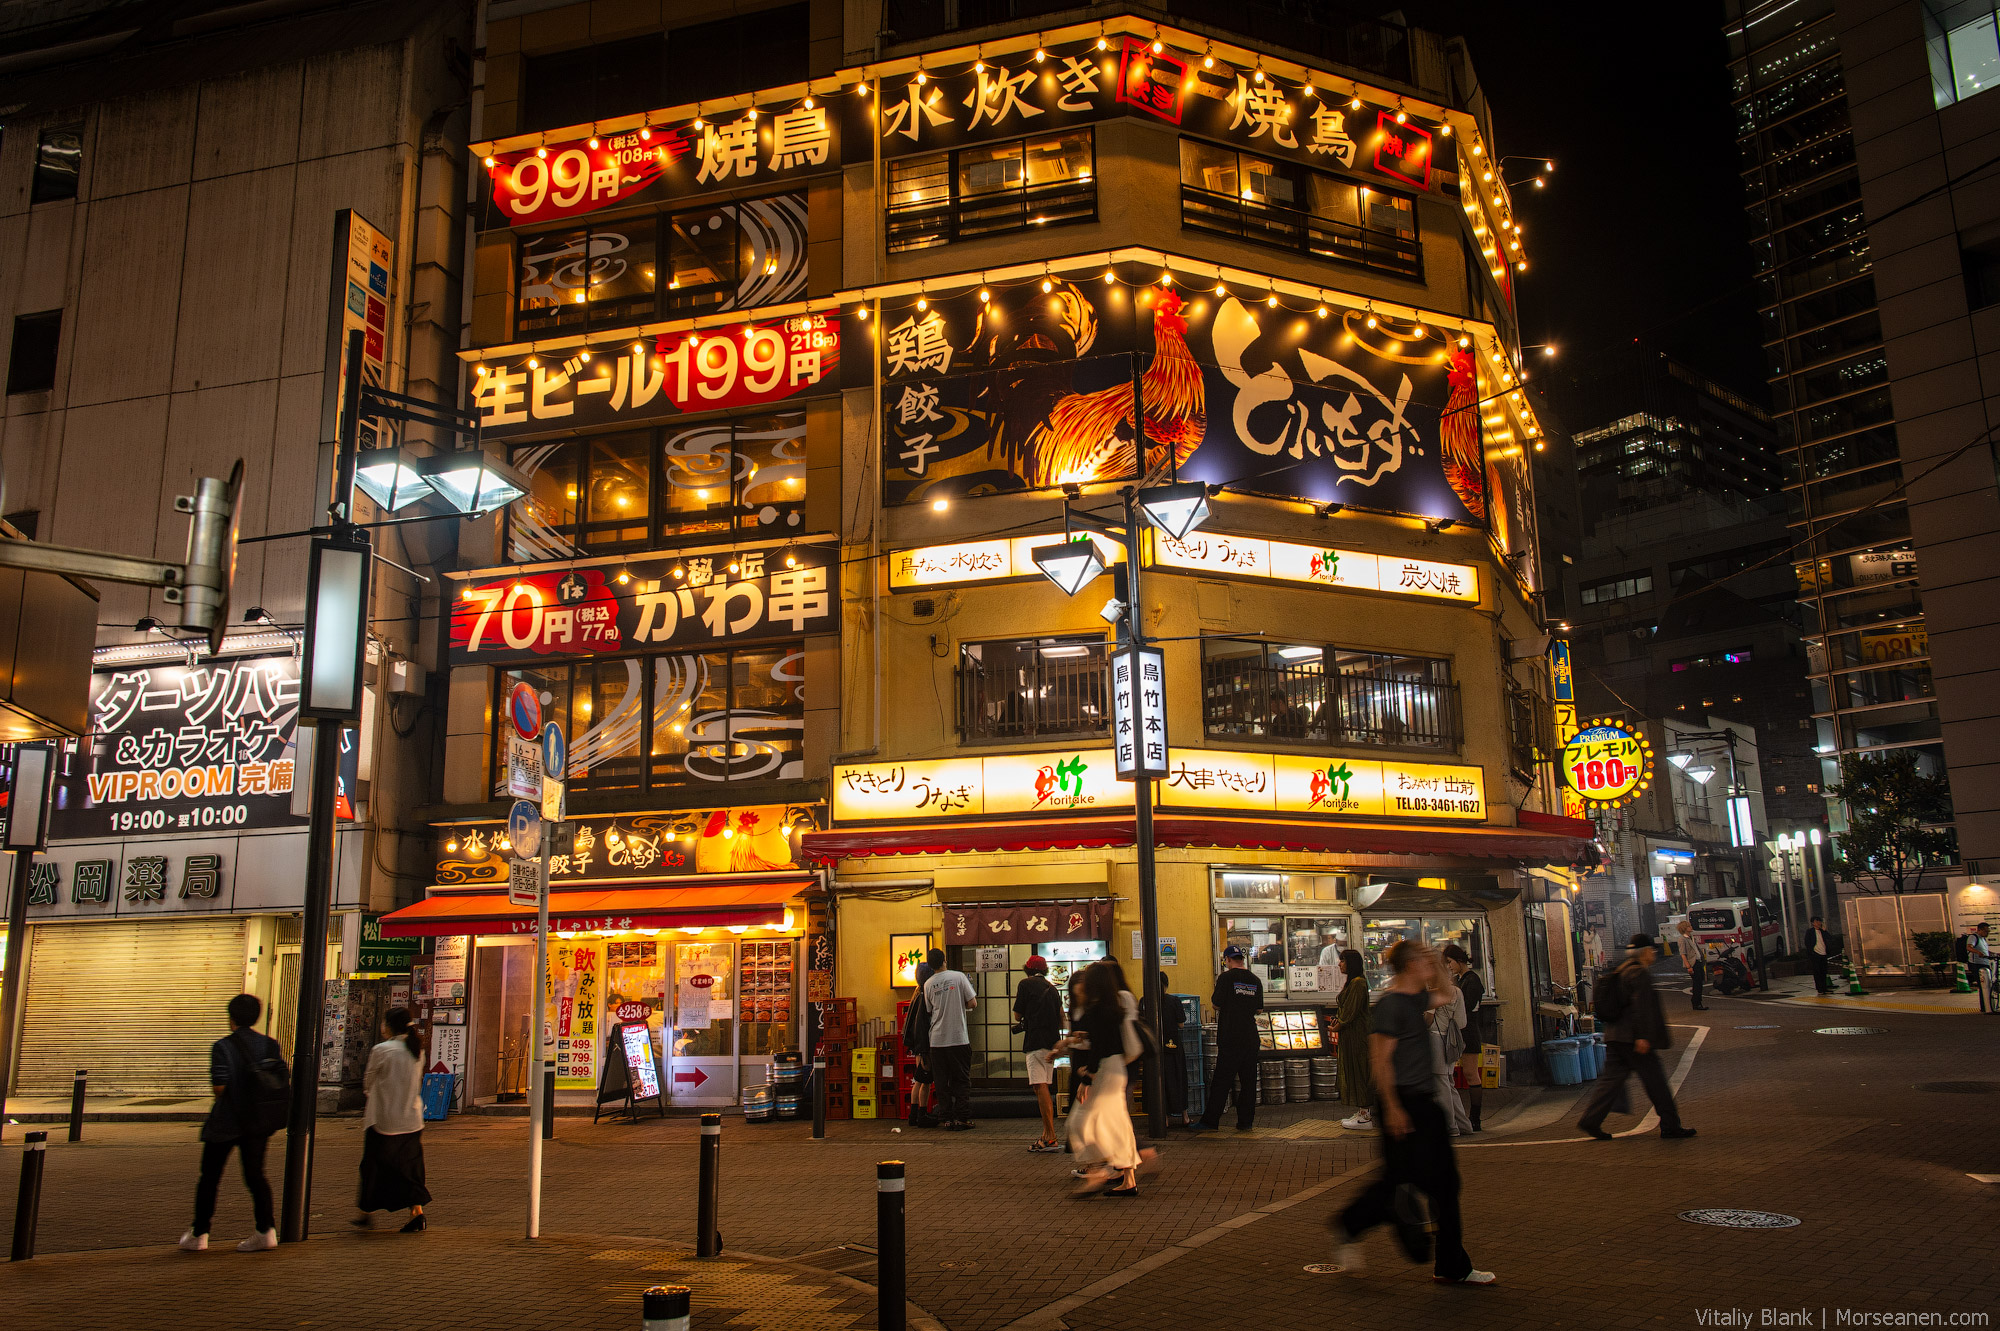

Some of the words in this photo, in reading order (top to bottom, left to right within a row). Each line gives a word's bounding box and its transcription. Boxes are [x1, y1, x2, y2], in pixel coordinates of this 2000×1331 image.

[884, 55, 1100, 141] 水炊き
[1225, 72, 1357, 168] 焼鳥
[696, 107, 831, 185] 焼鳥
[666, 329, 821, 402] 199円
[471, 352, 665, 428] 生ビール
[887, 310, 953, 475] 鶏餃子
[688, 553, 764, 584] 秘伝
[950, 552, 1002, 571] 水炊き
[1162, 535, 1208, 559] やきとり
[1218, 540, 1257, 568] うなぎ
[1400, 564, 1462, 595] 炭火焼
[467, 587, 573, 652] 70円
[633, 563, 828, 643] かわ串
[96, 661, 300, 732] ダーツバー
[1117, 665, 1132, 762] 鳥竹本店
[1144, 663, 1162, 761] 鳥竹本店
[116, 720, 281, 768] &カラオケ
[1567, 740, 1638, 763] プレモル
[1580, 731, 1620, 743] PREMIUM
[88, 764, 233, 804] VIPROOM
[239, 759, 294, 794] 完備
[842, 767, 905, 793] やきとり
[913, 777, 974, 811] うなぎ
[1169, 762, 1215, 791] 大串
[1217, 768, 1266, 793] やきとり
[1445, 774, 1475, 796] 出前
[1572, 759, 1637, 790] 180円
[1050, 794, 1095, 806] toritake
[1322, 798, 1359, 810] toritake
[110, 810, 165, 830] 19:00
[517, 815, 530, 851] P
[576, 826, 596, 849] 鳥
[359, 955, 383, 967] くすり
[573, 947, 595, 1034] 飲みたい放題
[617, 1004, 650, 1018] 全258席
[453, 1029, 461, 1061] SHISHA
